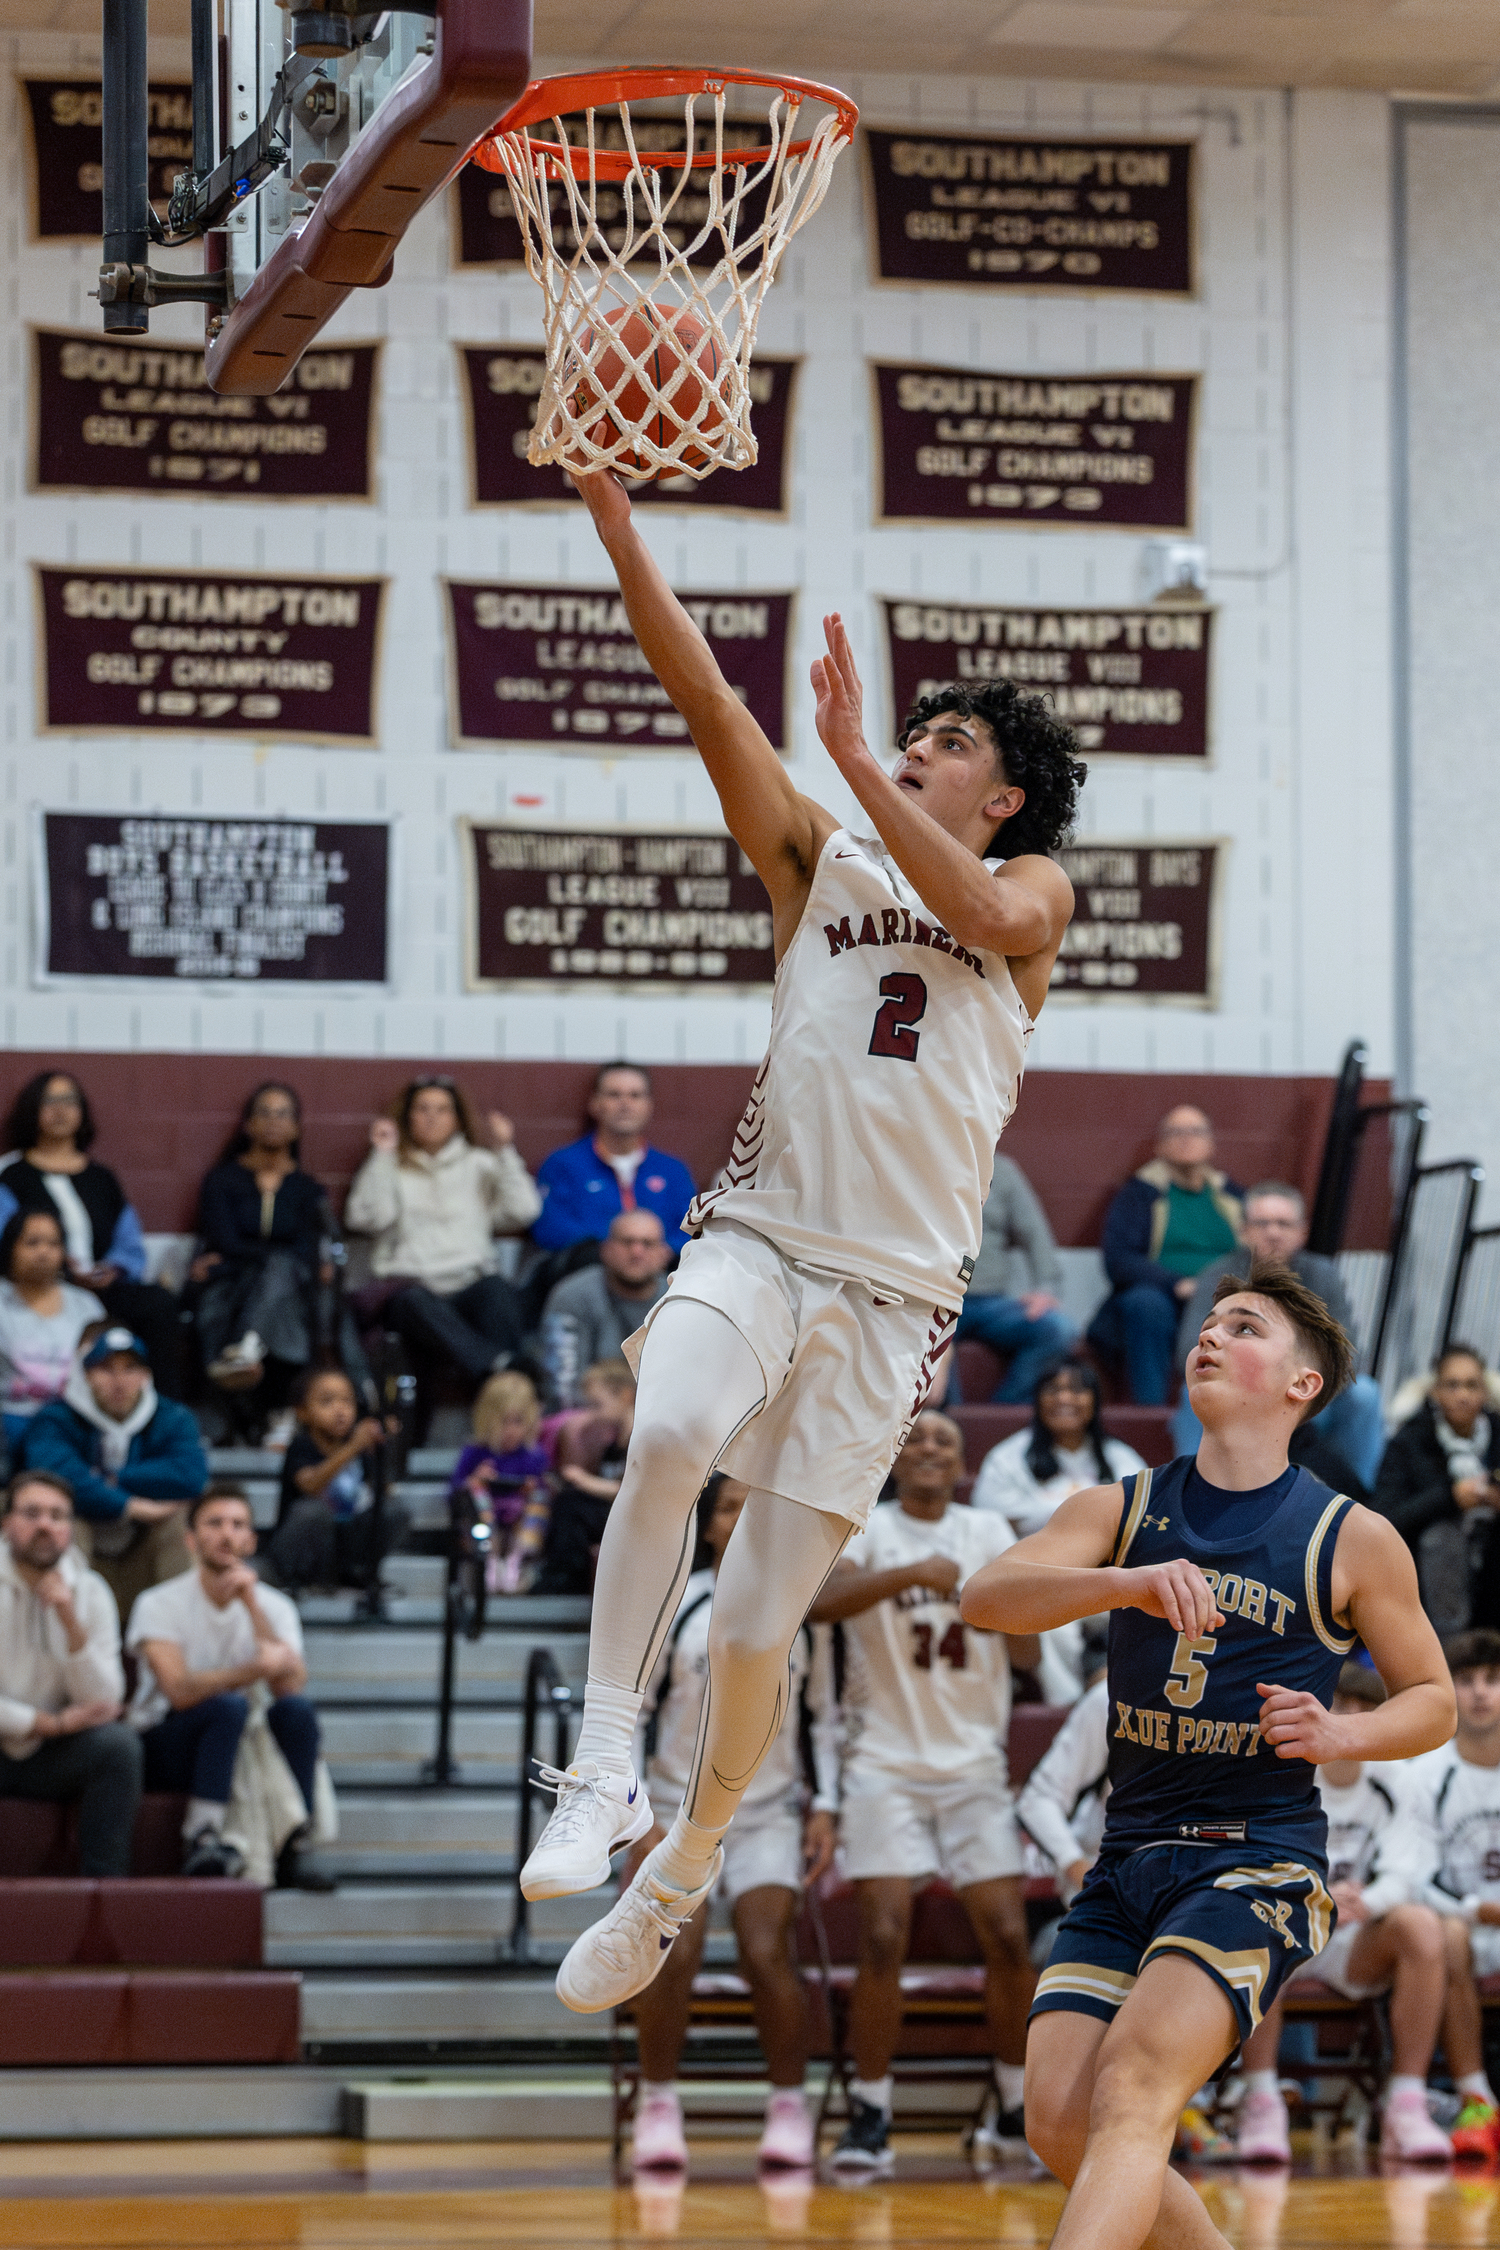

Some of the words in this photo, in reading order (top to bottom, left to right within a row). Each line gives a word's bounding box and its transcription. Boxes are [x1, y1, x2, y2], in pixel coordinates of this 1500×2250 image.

[890, 141, 1170, 186] SOUTHAMPTON
[930, 186, 1078, 211] LEAGUE
[101, 387, 256, 418] LEAGUE
[898, 375, 1176, 422] SOUTHAMPTON
[81, 413, 161, 448] GOLF
[168, 420, 328, 455] CHAMPIONS
[936, 418, 1083, 446] LEAGUE
[915, 446, 991, 477] GOLF
[996, 449, 1154, 485] CHAMPIONS
[62, 579, 361, 628] SOUTHAMPTON
[472, 591, 770, 640] SOUTHATON
[129, 624, 290, 654] COUNTY
[893, 605, 1203, 651] SOUTHAMPTON
[86, 652, 165, 685] GOLF
[170, 656, 334, 692] CHAMPIONS
[956, 648, 1072, 683] LEAGUE
[494, 675, 575, 703] GOLF
[547, 873, 662, 907] LEAGUE
[503, 905, 588, 946] GOLF
[602, 909, 774, 950] CHAMPIONS
[867, 972, 928, 1062] 2
[1200, 1567, 1297, 1637] PORT
[1164, 1632, 1217, 1709] 5
[1177, 1716, 1262, 1757] POINT
